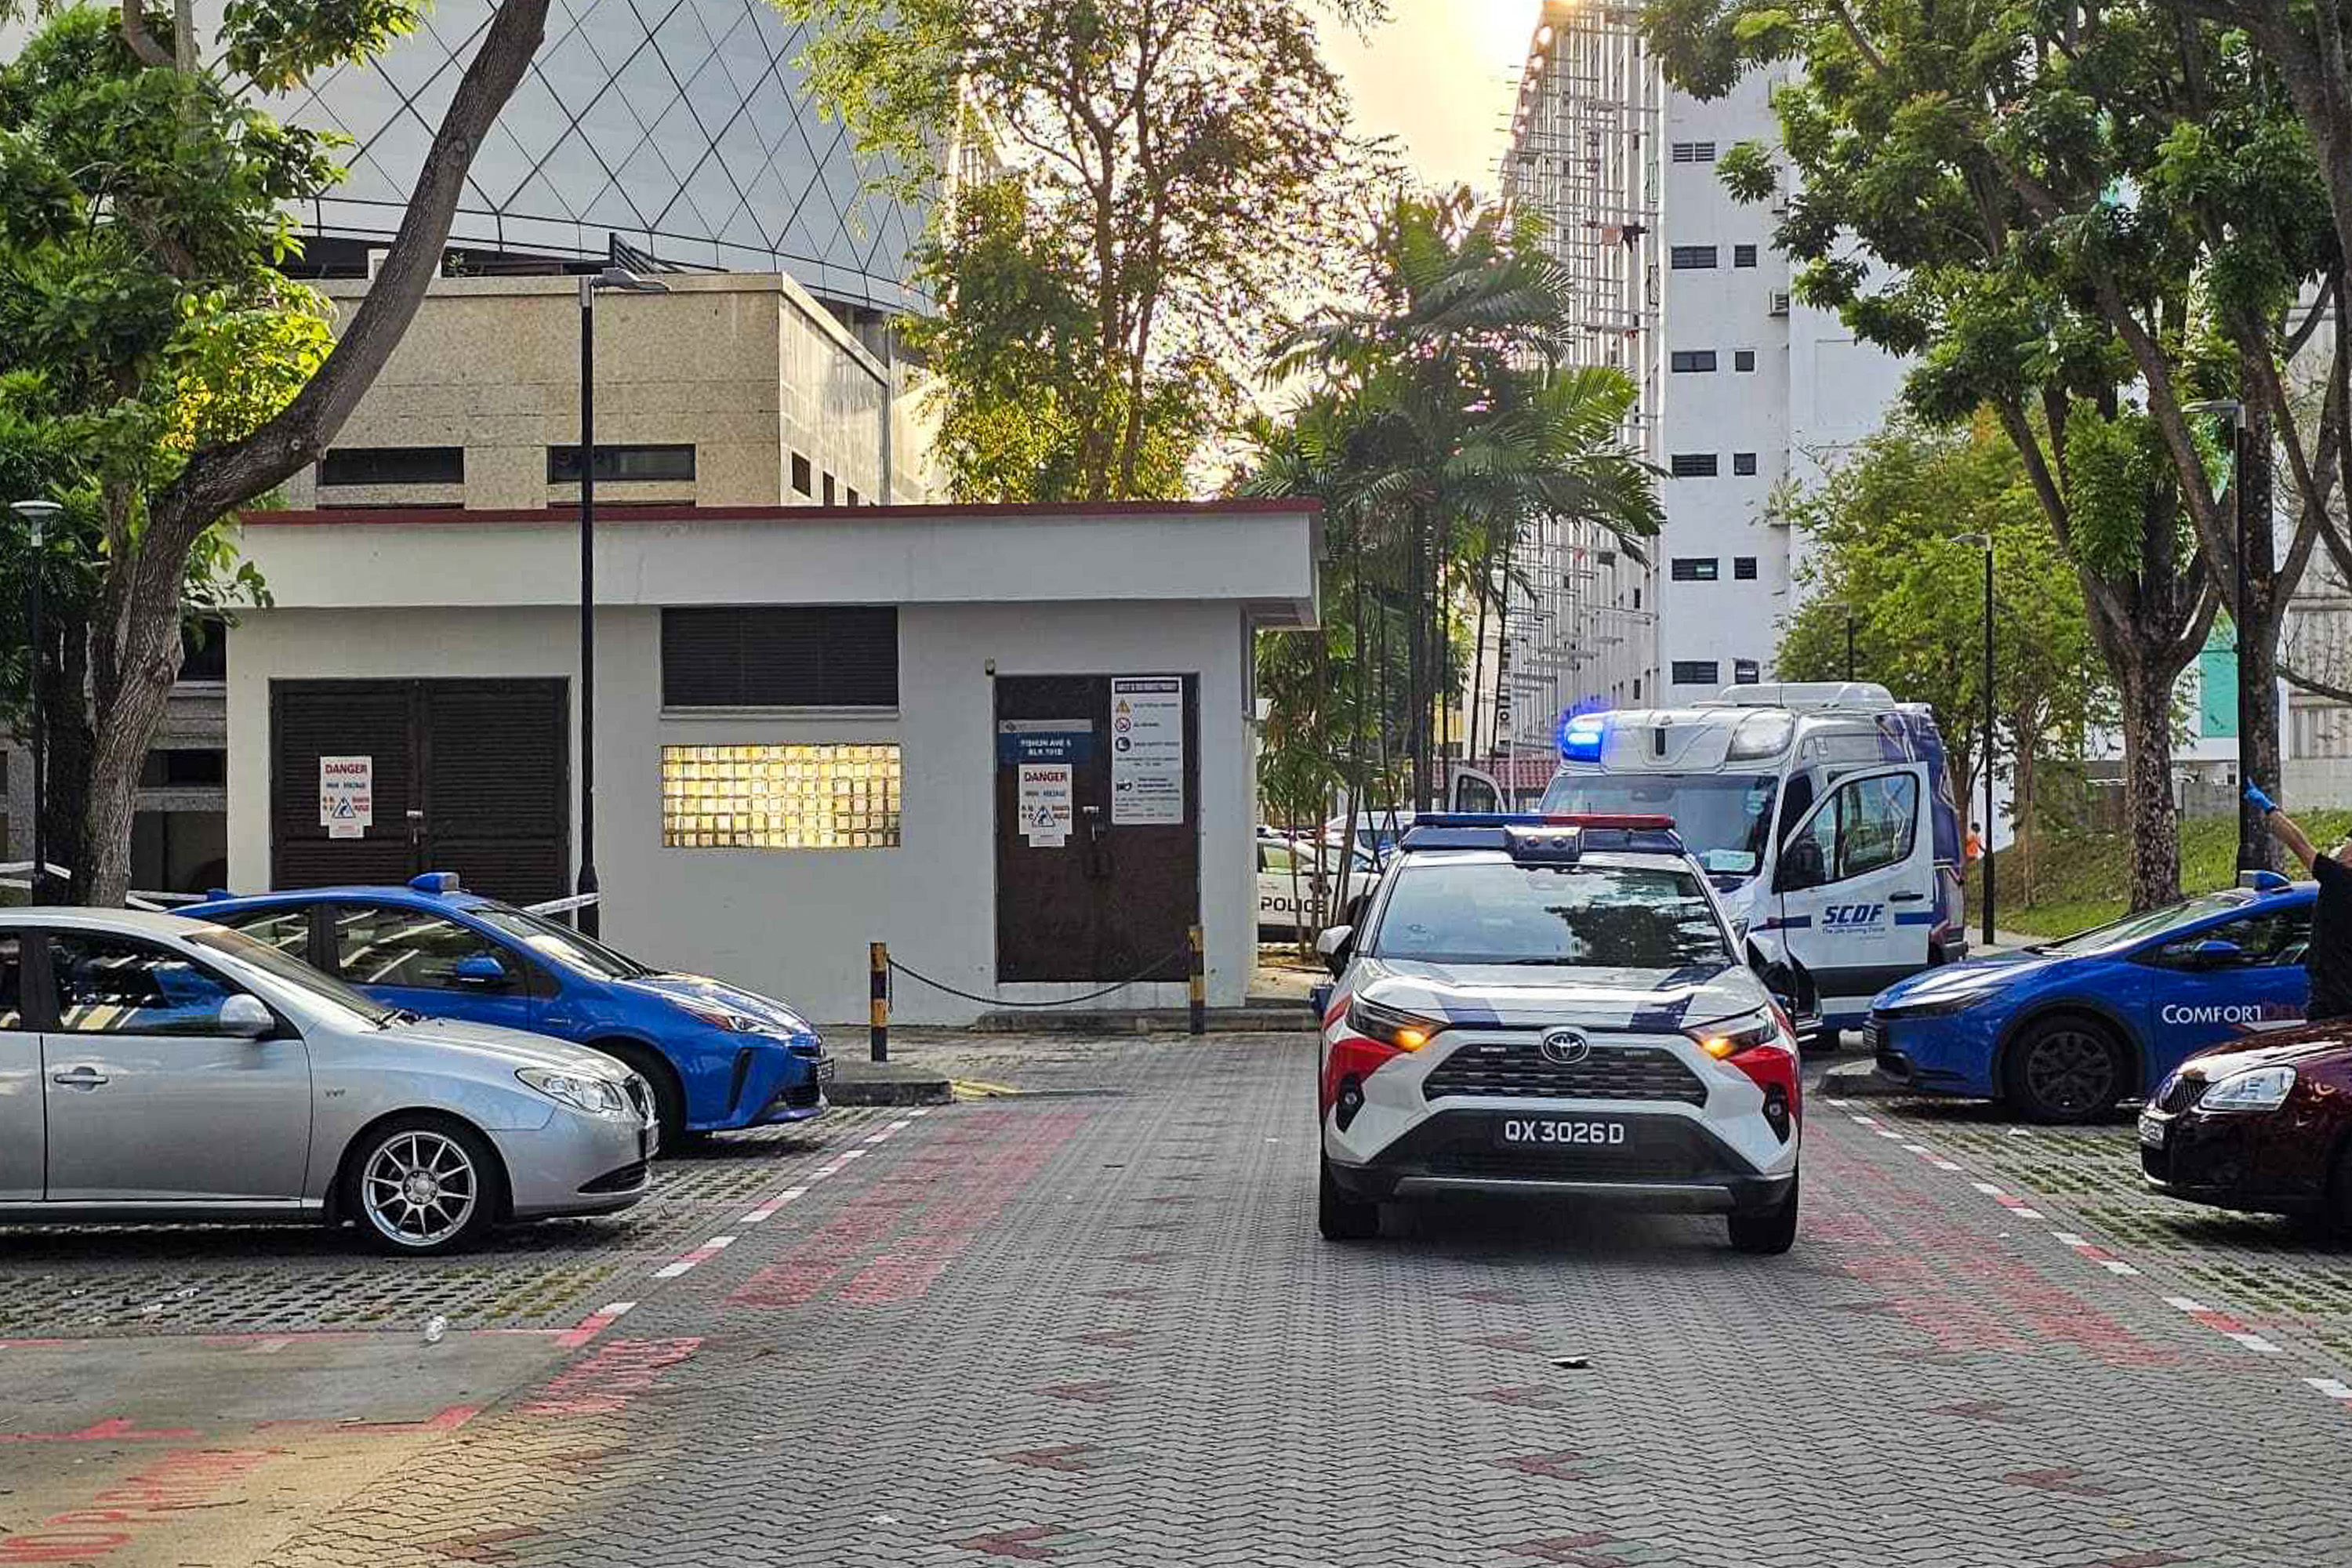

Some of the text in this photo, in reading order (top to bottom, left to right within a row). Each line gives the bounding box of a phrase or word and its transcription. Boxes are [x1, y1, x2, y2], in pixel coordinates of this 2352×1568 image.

[325, 763, 368, 775] DANGER
[1024, 771, 1068, 782] DANGER
[1821, 904, 1885, 924] SCDF
